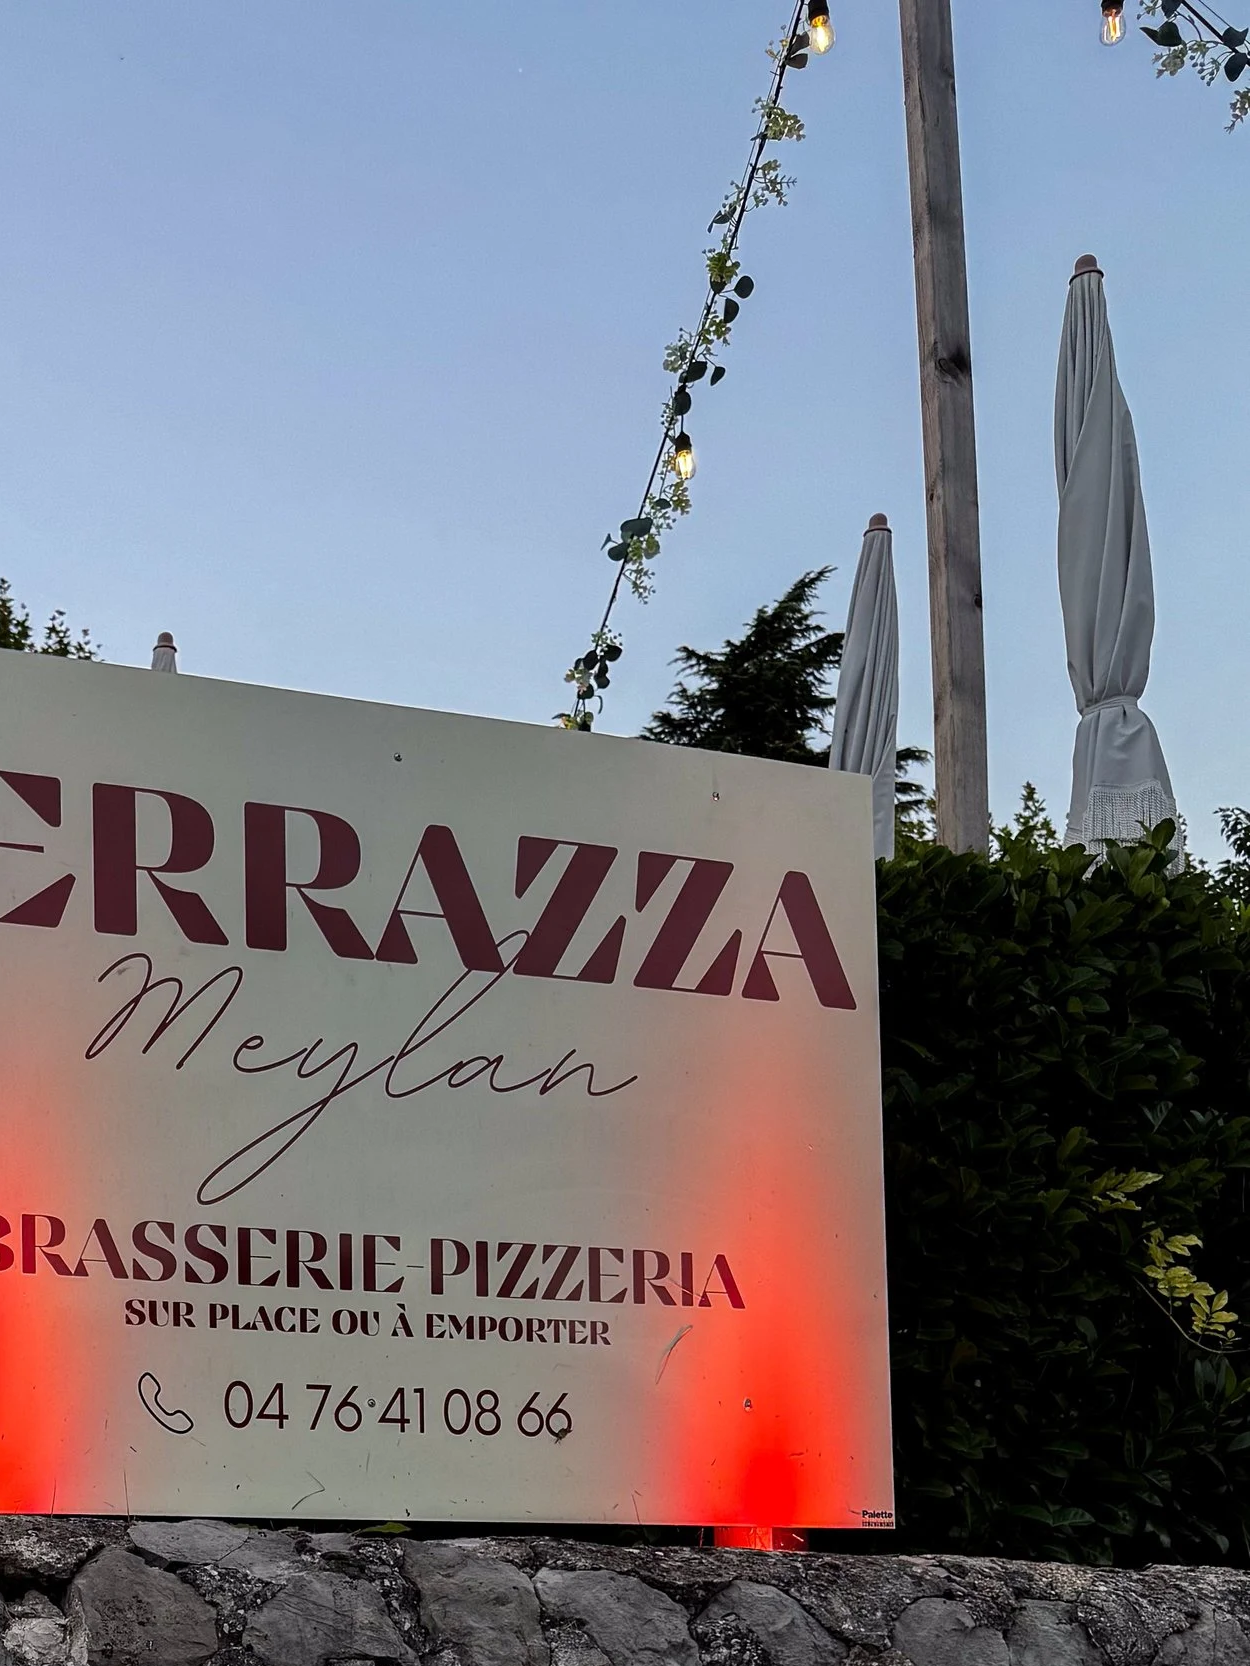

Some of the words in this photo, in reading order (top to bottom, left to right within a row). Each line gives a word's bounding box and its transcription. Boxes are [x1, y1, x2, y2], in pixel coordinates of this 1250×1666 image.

[85, 930, 639, 1205] Meylan
[124, 1298, 197, 1328] SUR
[208, 1302, 322, 1334] PLACE
[331, 1308, 381, 1336] OU
[391, 1303, 415, 1338] À
[425, 1312, 612, 1346] EMPORTER
[223, 1380, 290, 1430] 04
[305, 1383, 363, 1432] 76
[377, 1386, 426, 1434] 41
[443, 1387, 502, 1437] 08
[516, 1391, 573, 1439] 66
